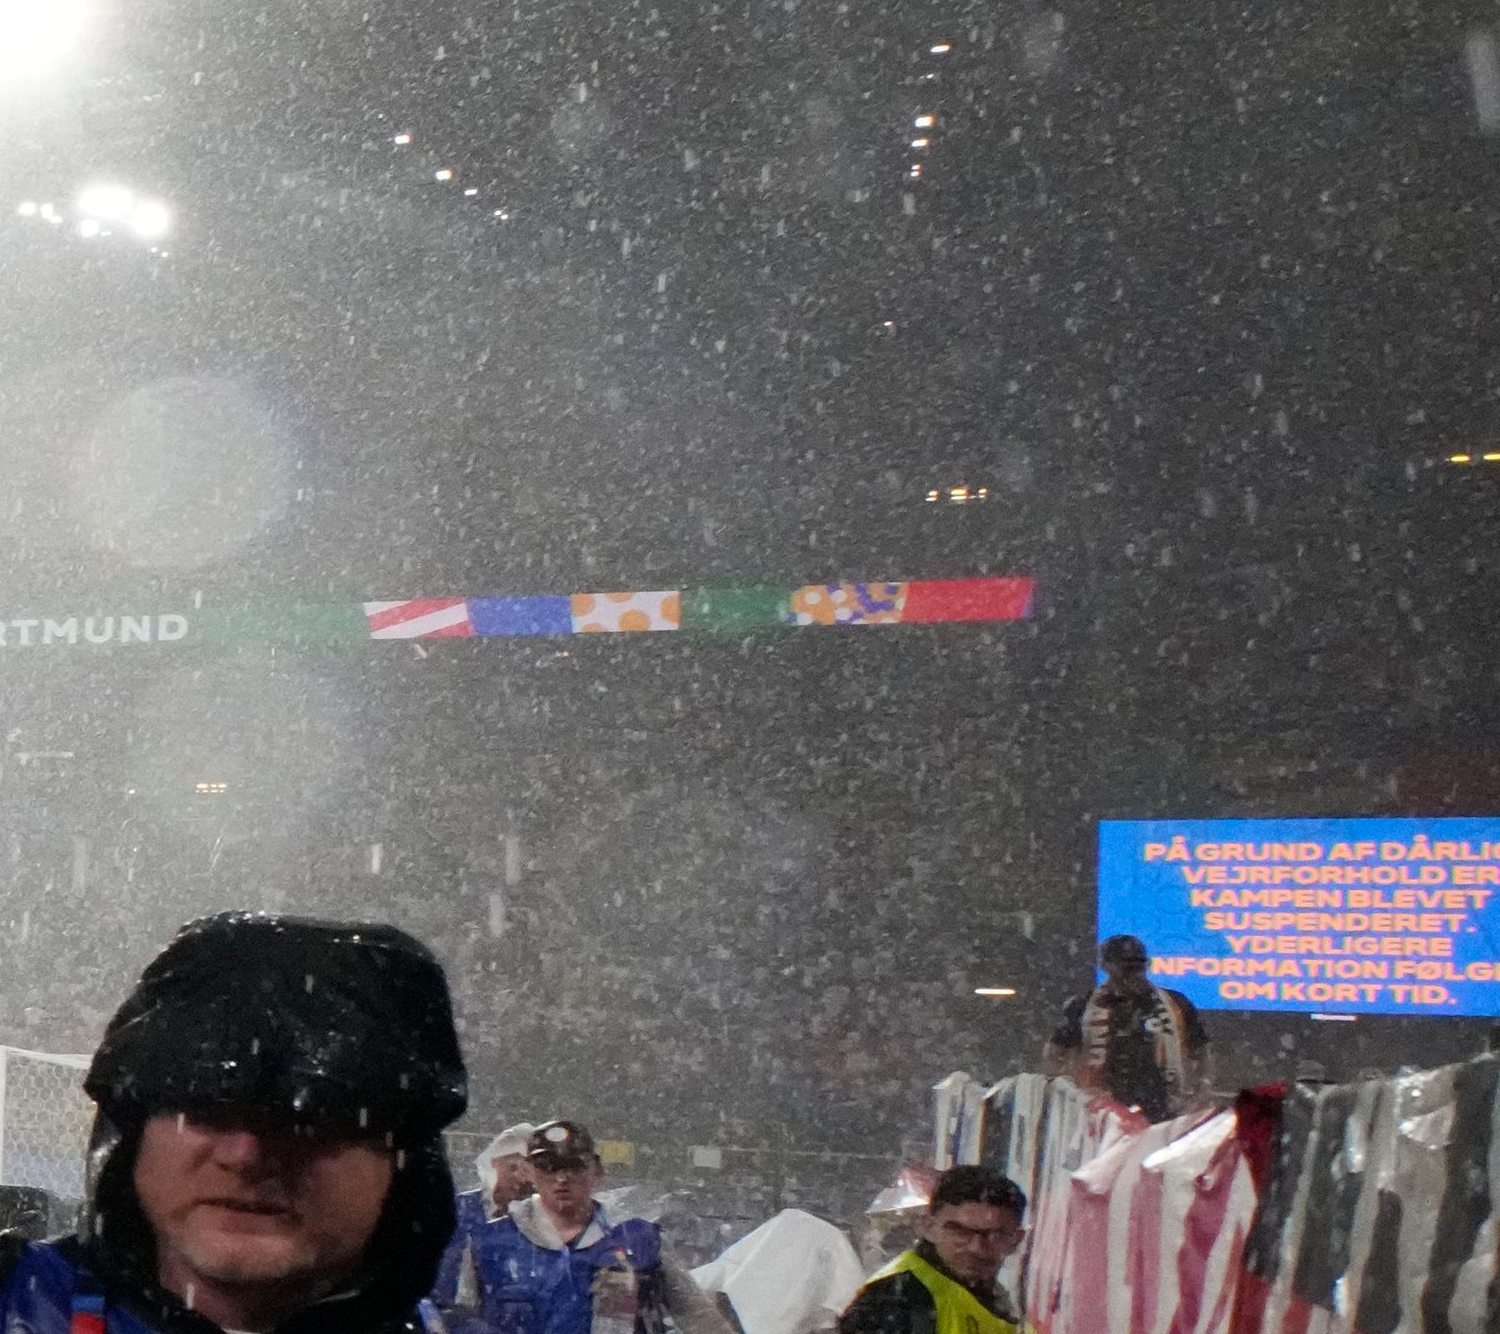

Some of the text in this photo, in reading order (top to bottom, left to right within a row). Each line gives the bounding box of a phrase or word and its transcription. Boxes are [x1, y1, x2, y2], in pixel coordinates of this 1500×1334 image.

[1145, 835, 1192, 861] PÅ
[1194, 842, 1322, 862] GRUND
[1328, 842, 1376, 861] AF
[1182, 865, 1447, 886] VEJRFORHOLD
[1190, 889, 1494, 910] KAMPEN BLEVET
[1204, 912, 1478, 934] SUSPENDERET.
[1227, 935, 1454, 957] YDERLIGERE
[1151, 956, 1389, 980] NFORMATION
[1218, 980, 1458, 1005] OM KORT TID.
